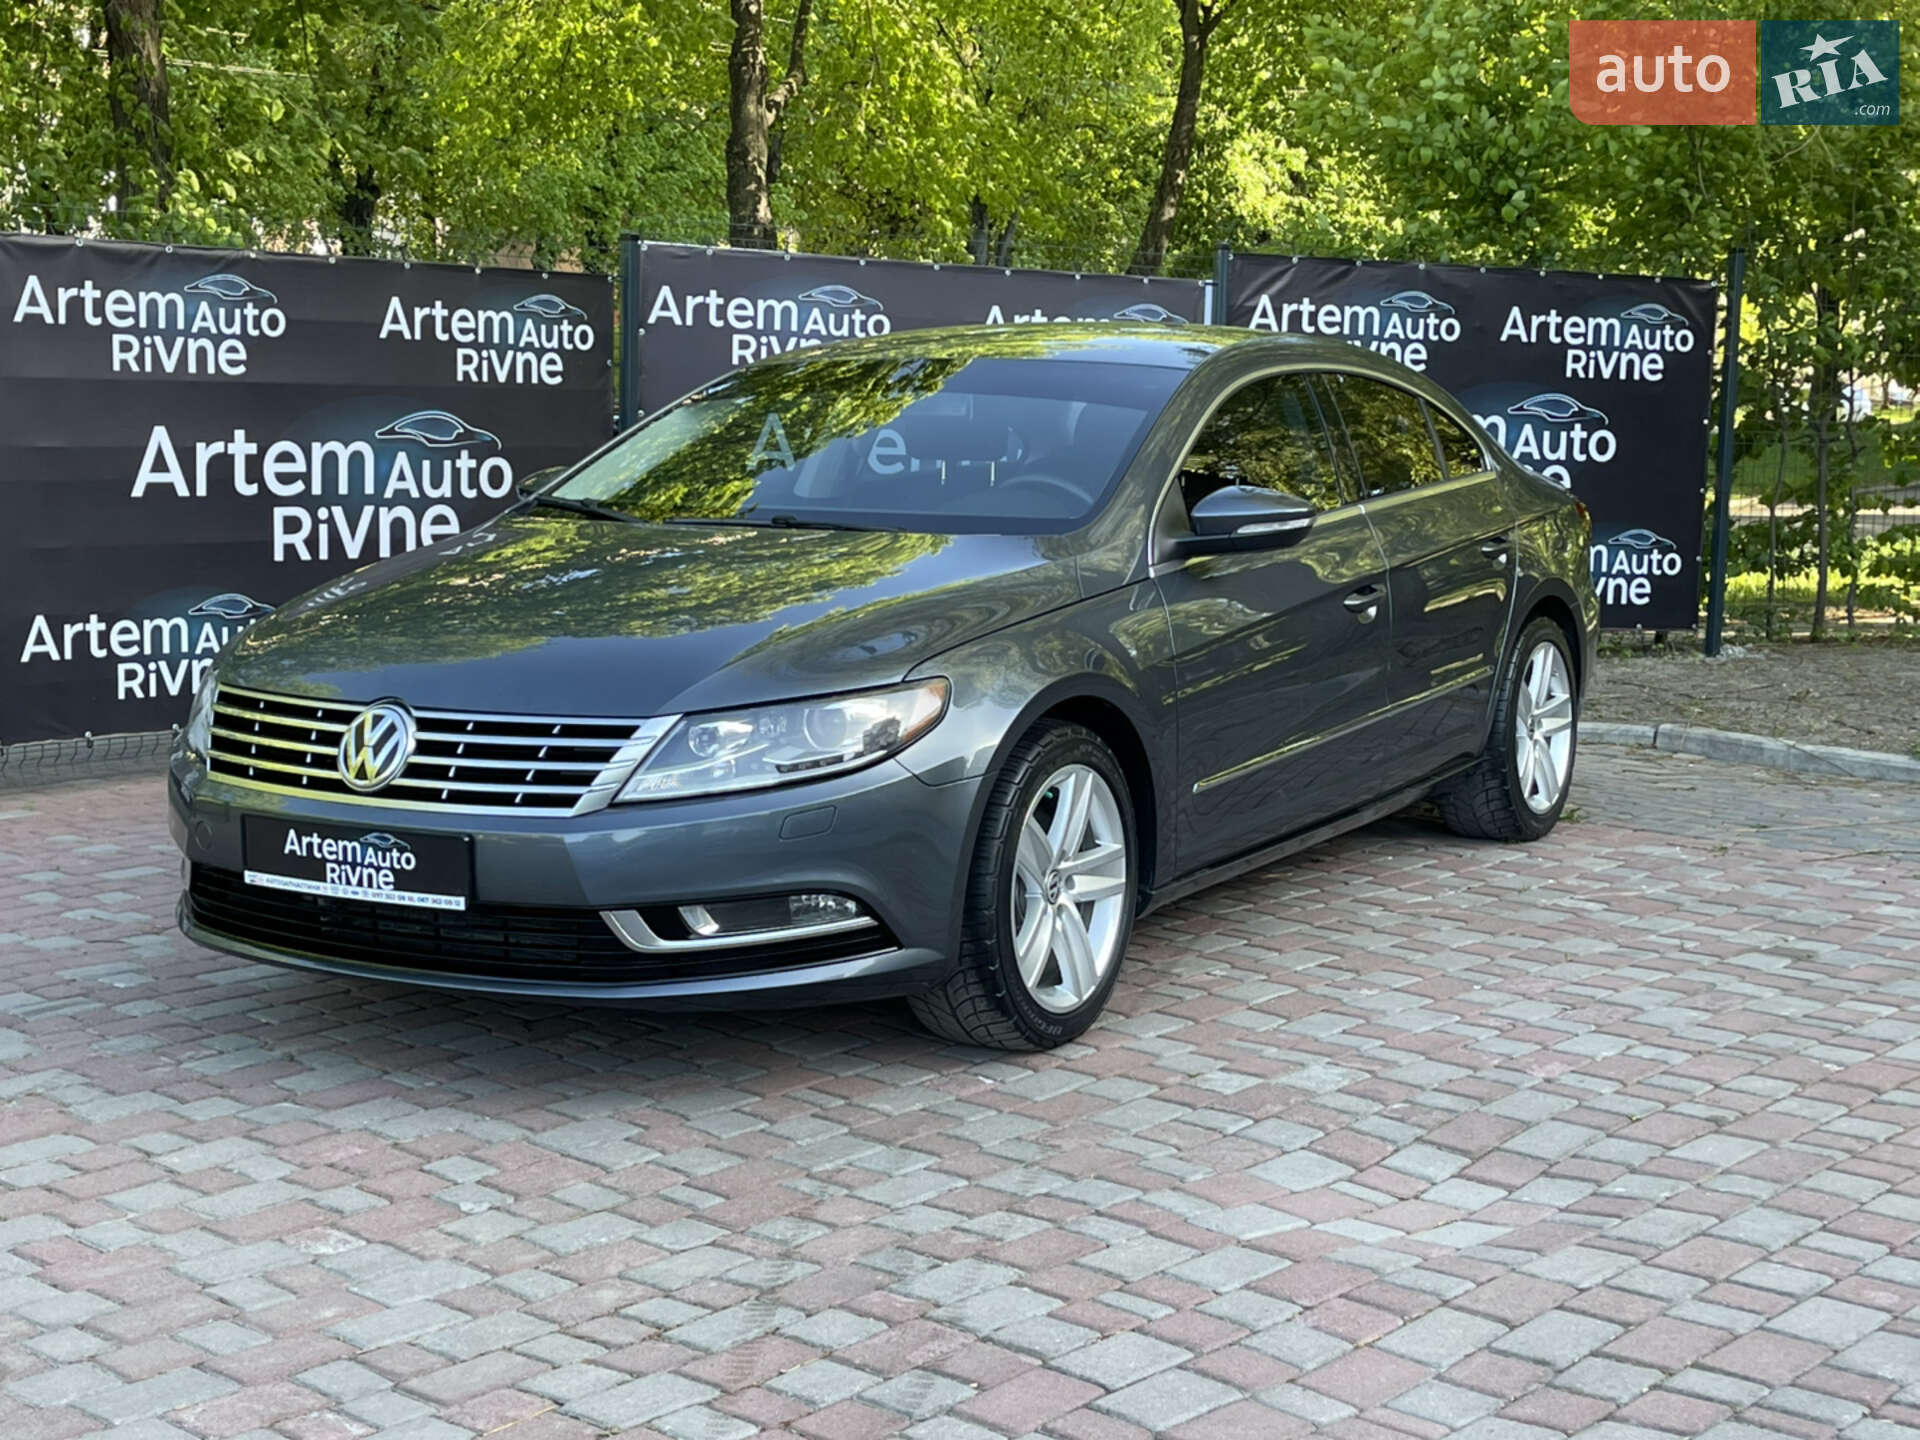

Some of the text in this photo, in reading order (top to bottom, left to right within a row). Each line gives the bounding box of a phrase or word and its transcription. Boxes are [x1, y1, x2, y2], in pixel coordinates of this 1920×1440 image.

[13, 274, 287, 338] Artem Auto
[378, 296, 595, 351] Artem Auto
[647, 285, 891, 338] Artem Auto
[1248, 294, 1461, 342] Artem Auto
[1499, 306, 1695, 353] Artem Auto
[130, 425, 513, 499] Artem Auto
[1512, 422, 1617, 463] Auto
[1611, 549, 1682, 575] Auto
[20, 614, 189, 663] Artem
[284, 828, 417, 870] Artem Auto
